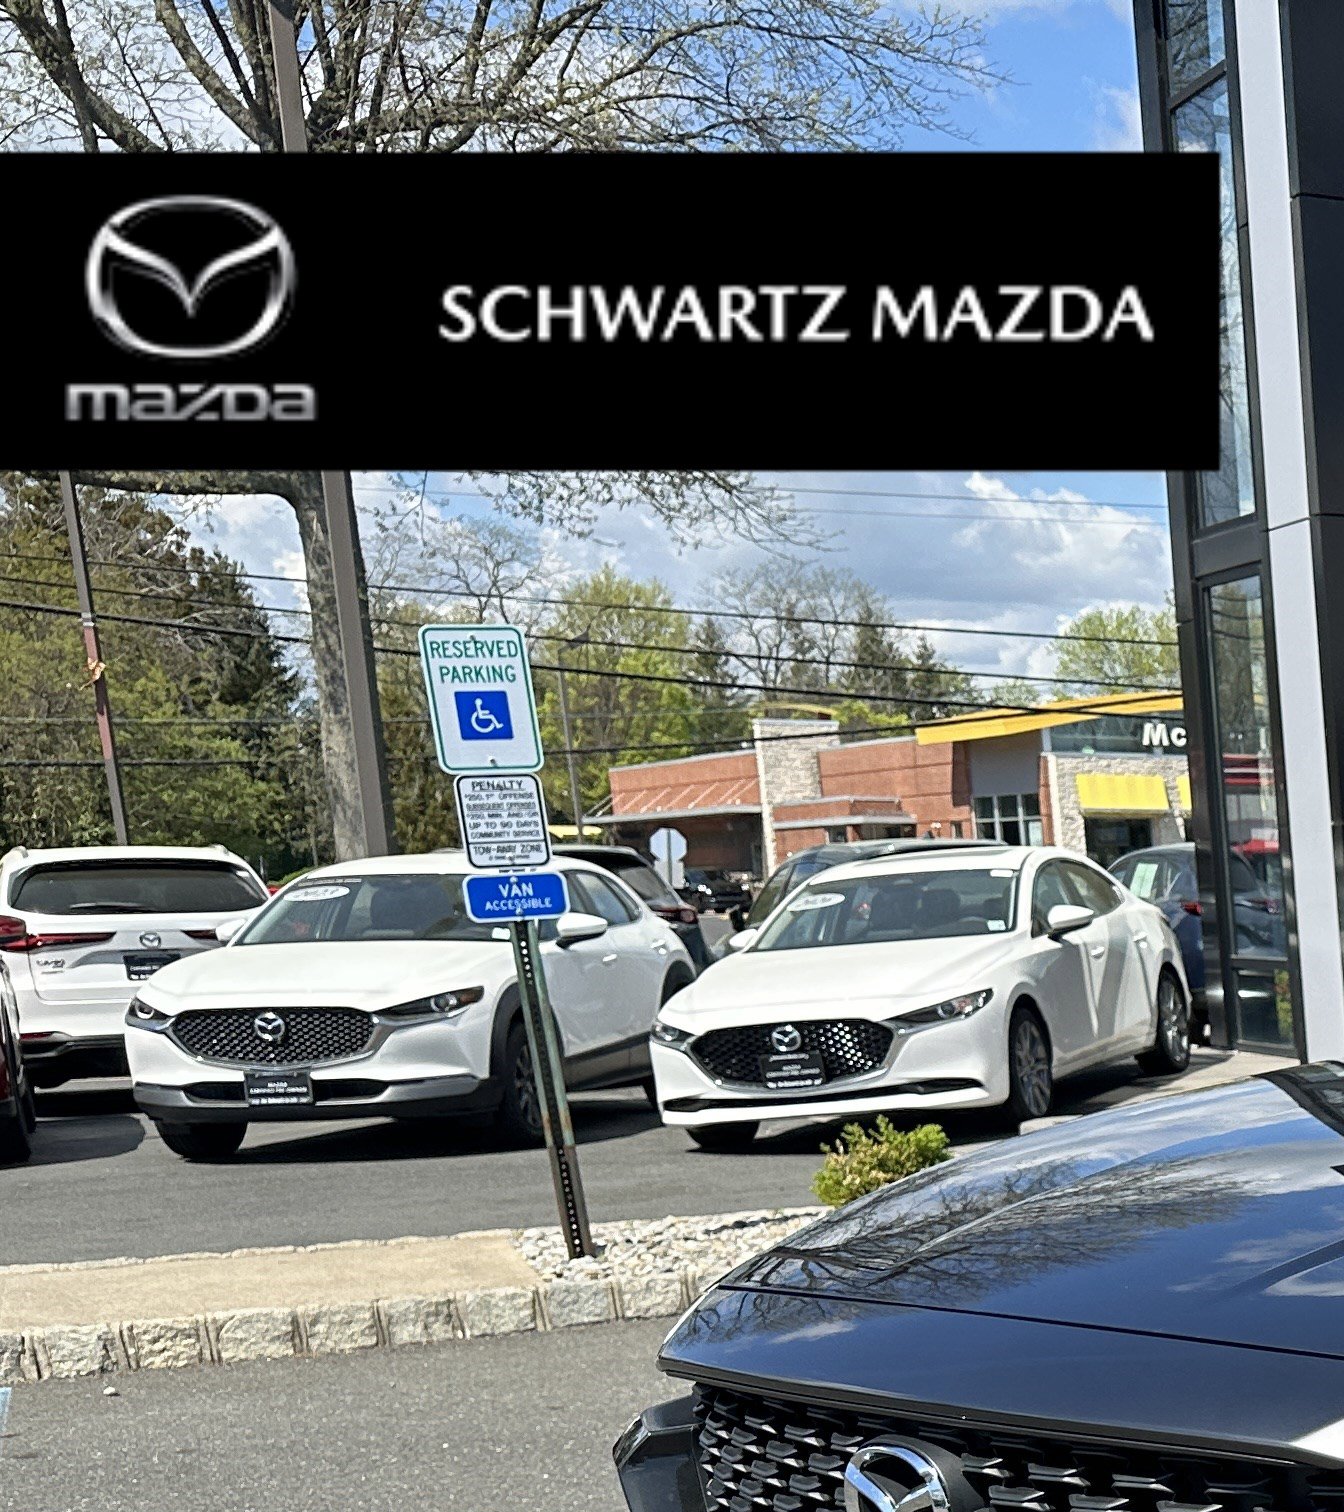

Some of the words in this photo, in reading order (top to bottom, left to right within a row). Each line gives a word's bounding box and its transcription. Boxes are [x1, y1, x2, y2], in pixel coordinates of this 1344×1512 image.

[430, 640, 518, 658] RESERVED
[440, 664, 516, 683] PARKING
[471, 780, 524, 791] PENALTY
[520, 844, 543, 853] ZONE
[498, 882, 534, 898] VAN
[485, 897, 552, 911] ACCESSIBLE
